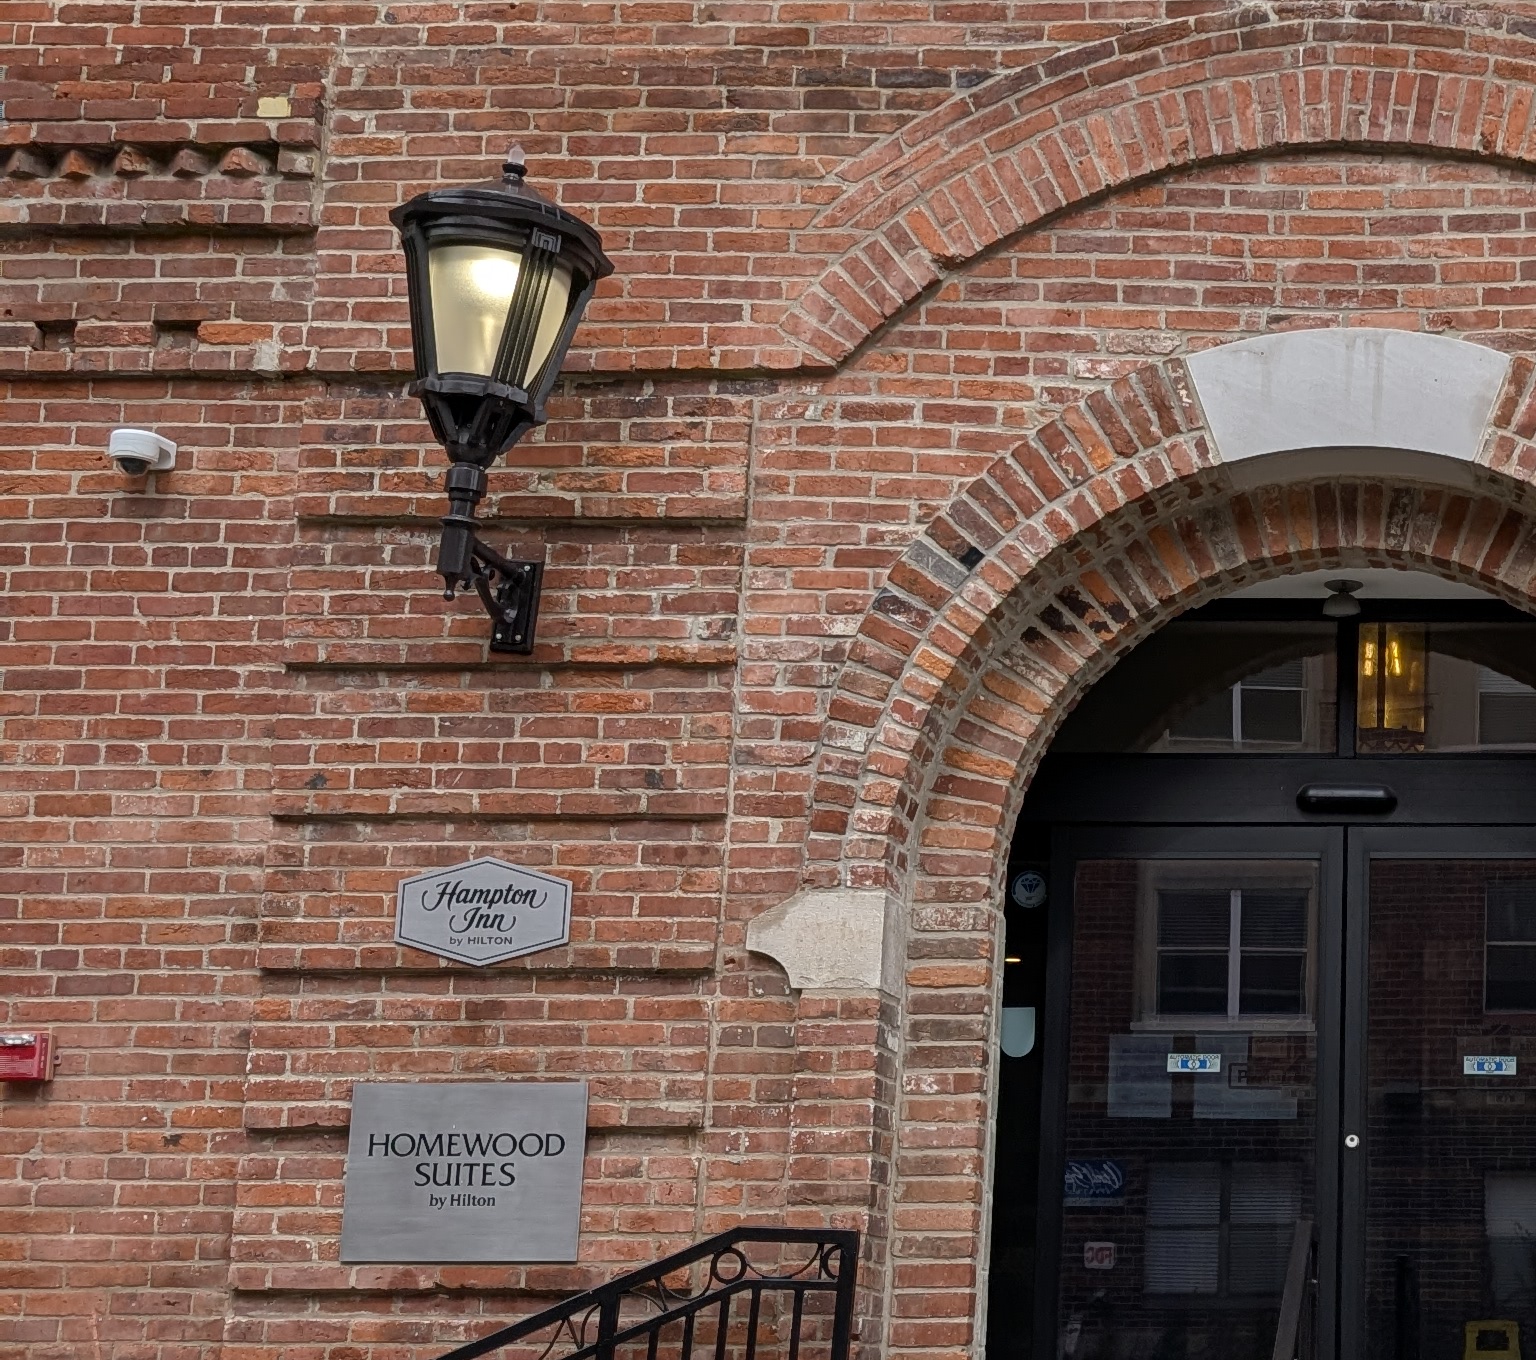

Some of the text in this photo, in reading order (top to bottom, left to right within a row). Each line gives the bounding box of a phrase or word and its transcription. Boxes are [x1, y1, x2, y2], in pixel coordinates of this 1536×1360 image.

[421, 880, 548, 912] Hampton
[449, 906, 517, 933] Inn
[449, 937, 513, 946] by HILTON
[368, 1133, 566, 1157] HOMEWOOD
[414, 1162, 516, 1187] SUITES
[429, 1193, 496, 1210] by Hilton
